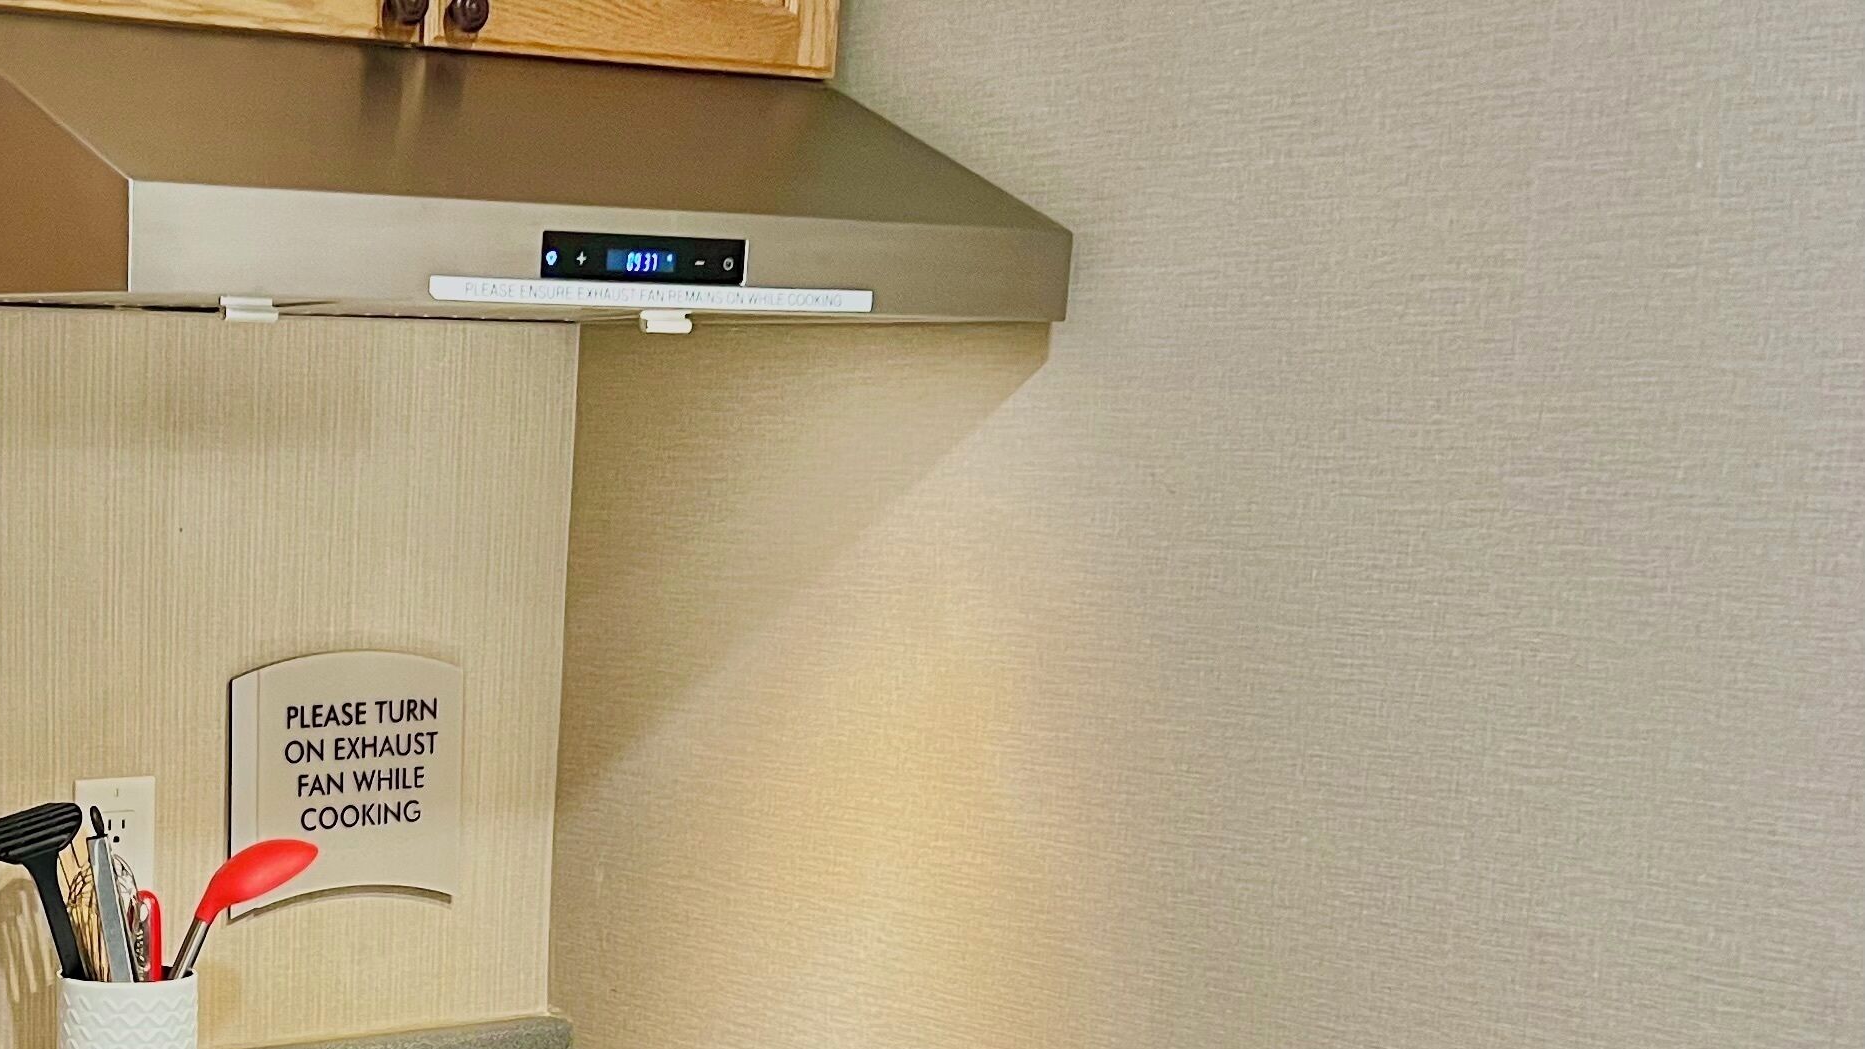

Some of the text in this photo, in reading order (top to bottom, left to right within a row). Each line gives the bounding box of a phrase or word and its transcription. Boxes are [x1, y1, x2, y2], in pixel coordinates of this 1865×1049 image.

[465, 282, 515, 298] PLEASE
[520, 284, 573, 300] ENSURE
[577, 286, 636, 301] EXHAUST
[640, 288, 664, 302] FAN
[727, 291, 744, 305] ON
[748, 292, 784, 306] WHILE
[788, 293, 843, 307] COOKING
[286, 698, 437, 729] PLEASE TURN
[285, 731, 438, 764] ON EXHAUST
[298, 766, 424, 797] FAN WHILE
[301, 800, 421, 831] COOKING
